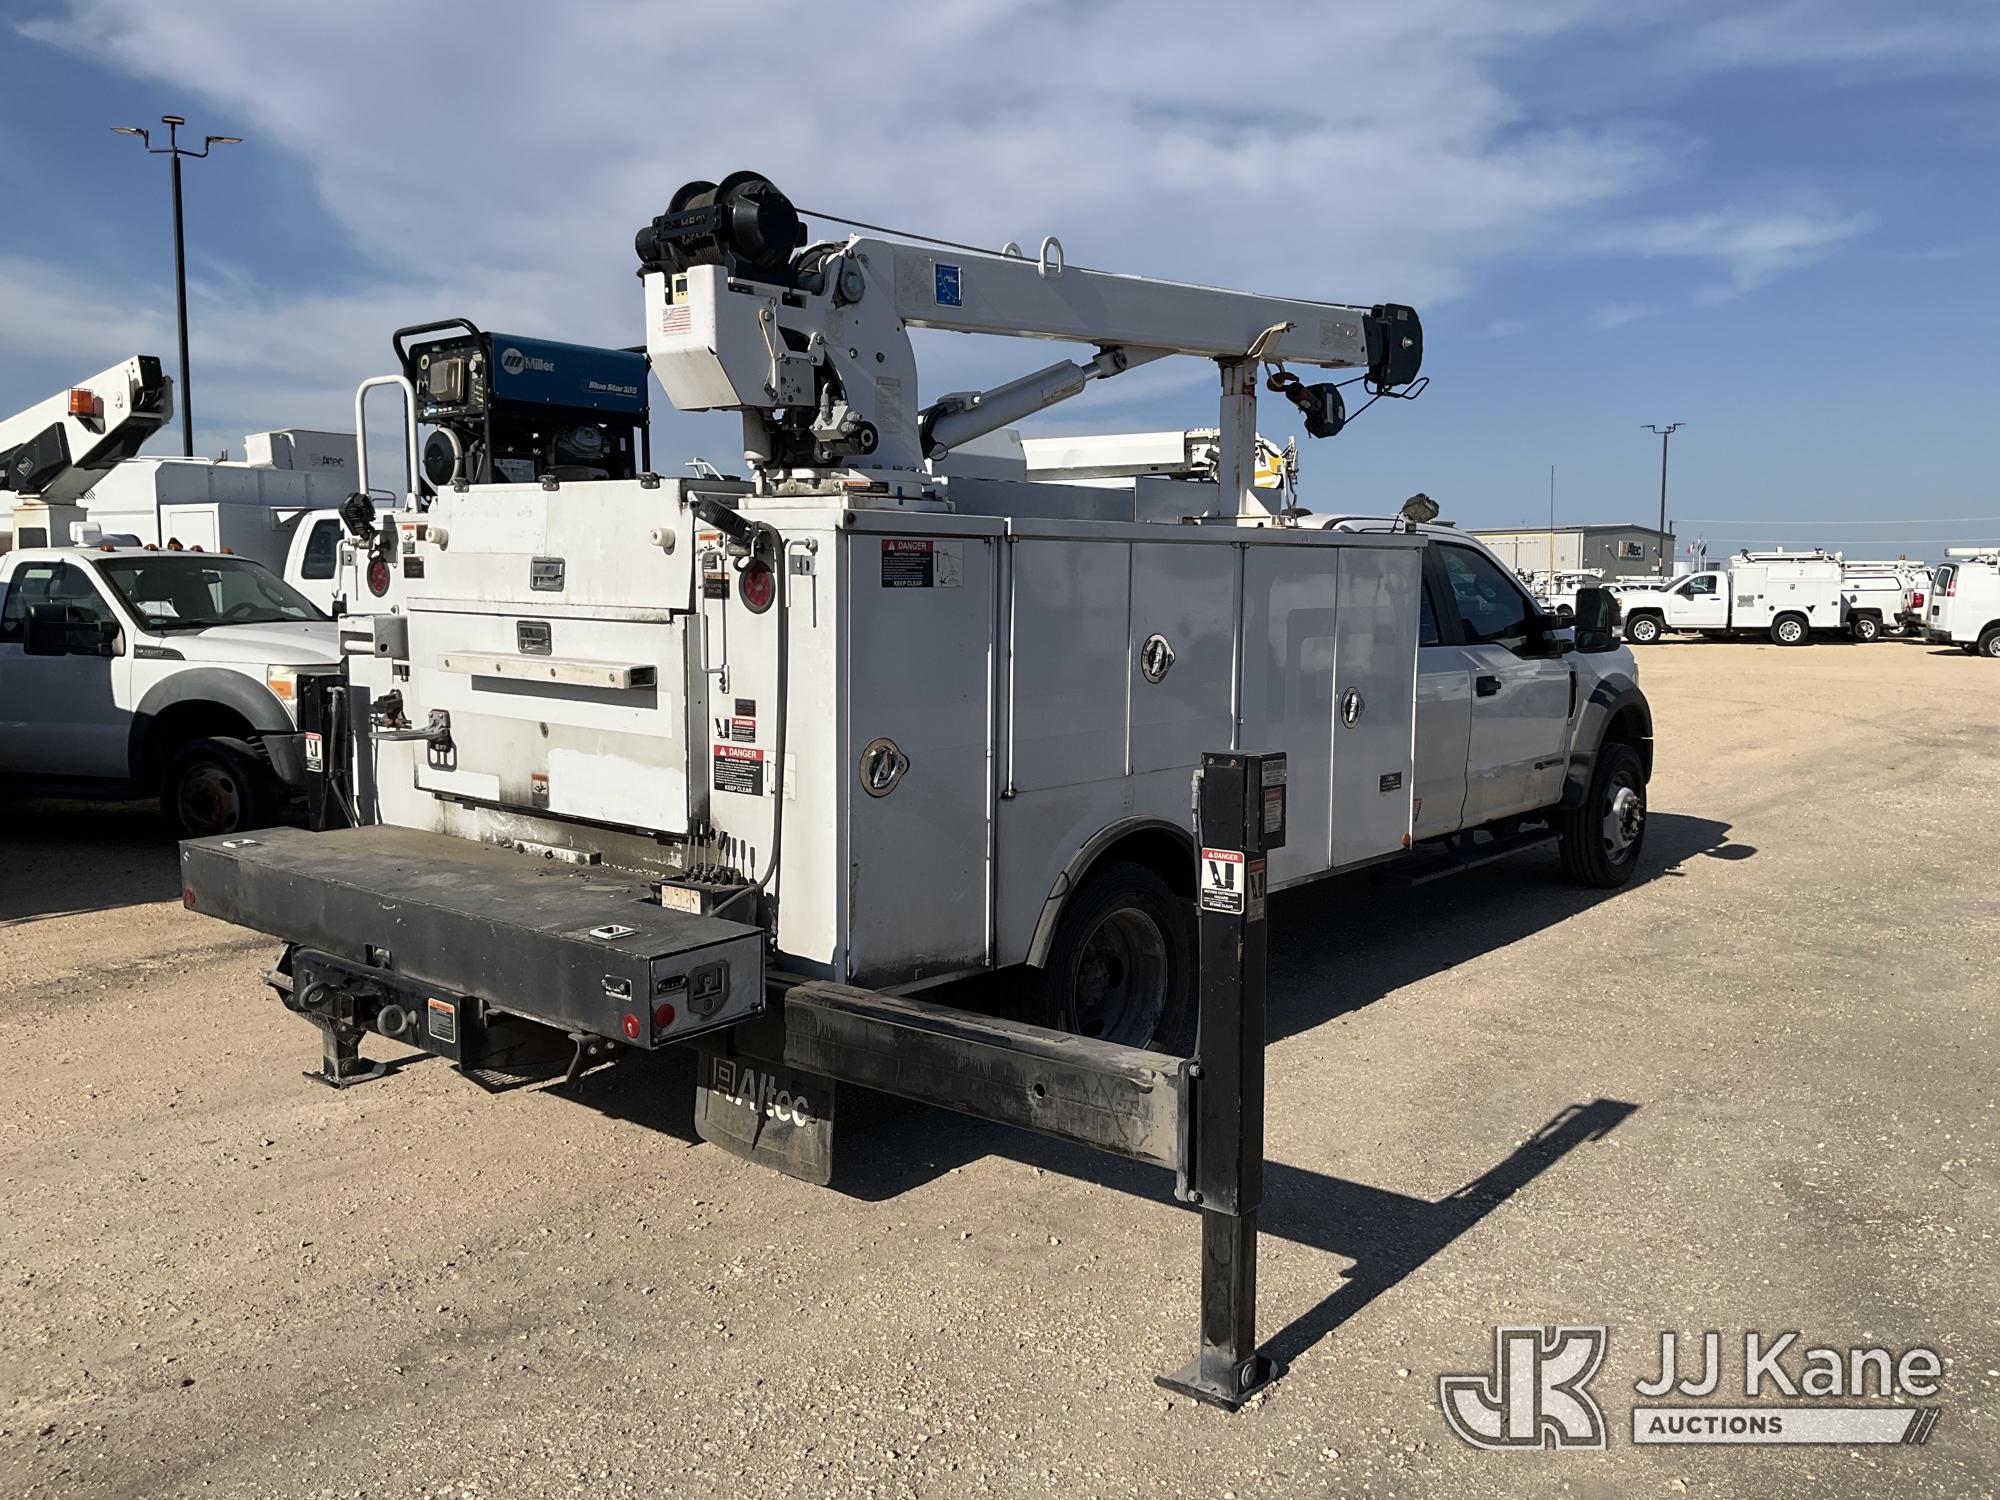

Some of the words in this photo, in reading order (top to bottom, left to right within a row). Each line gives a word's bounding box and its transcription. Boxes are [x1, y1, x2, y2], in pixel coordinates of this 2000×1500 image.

[524, 357, 555, 372] Miller
[607, 383, 624, 392] Star
[898, 541, 927, 550] DANGER
[728, 747, 757, 759] DANGER
[1213, 851, 1238, 861] DANGER
[735, 1067, 810, 1128] Altec
